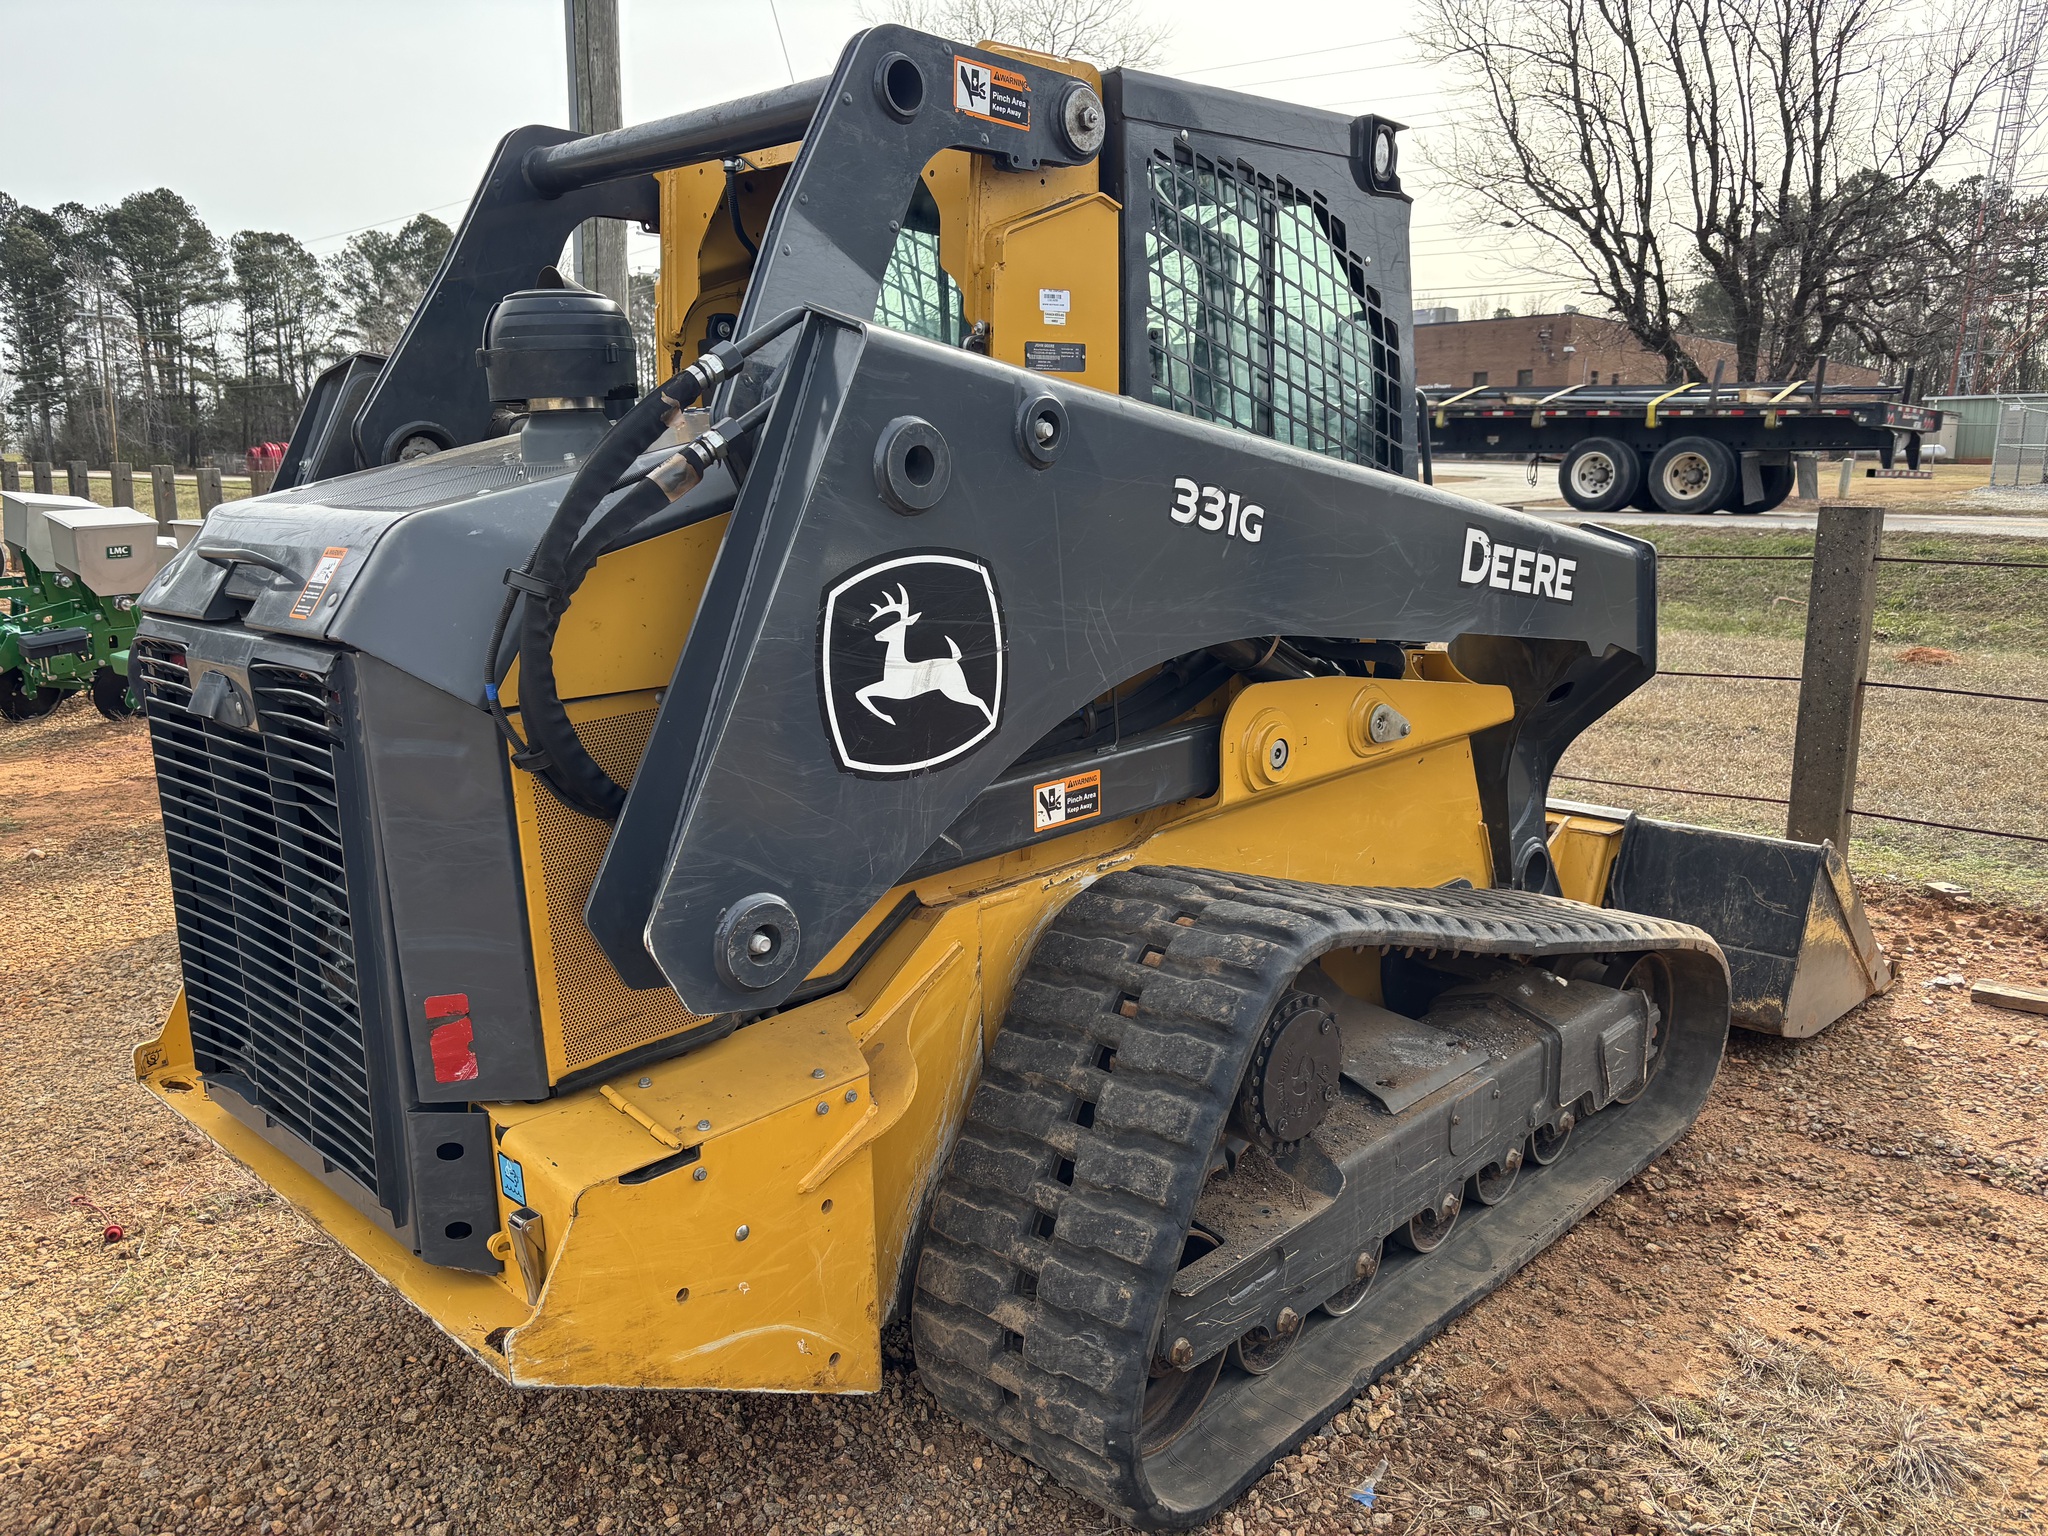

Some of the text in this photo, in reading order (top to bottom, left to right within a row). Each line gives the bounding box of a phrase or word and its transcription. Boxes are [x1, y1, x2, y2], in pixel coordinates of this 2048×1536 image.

[1000, 74, 1028, 89] WARNING
[992, 91, 1027, 108] Pinch Area
[992, 103, 1022, 119] Keep Away
[1170, 478, 1264, 542] 331G
[109, 546, 128, 555] LMC
[1461, 527, 1577, 601] DEERE
[1073, 775, 1098, 787] WARNING
[1067, 792, 1096, 805] Pinch Area
[1067, 806, 1079, 814] Keep
[1080, 803, 1092, 811] Away
